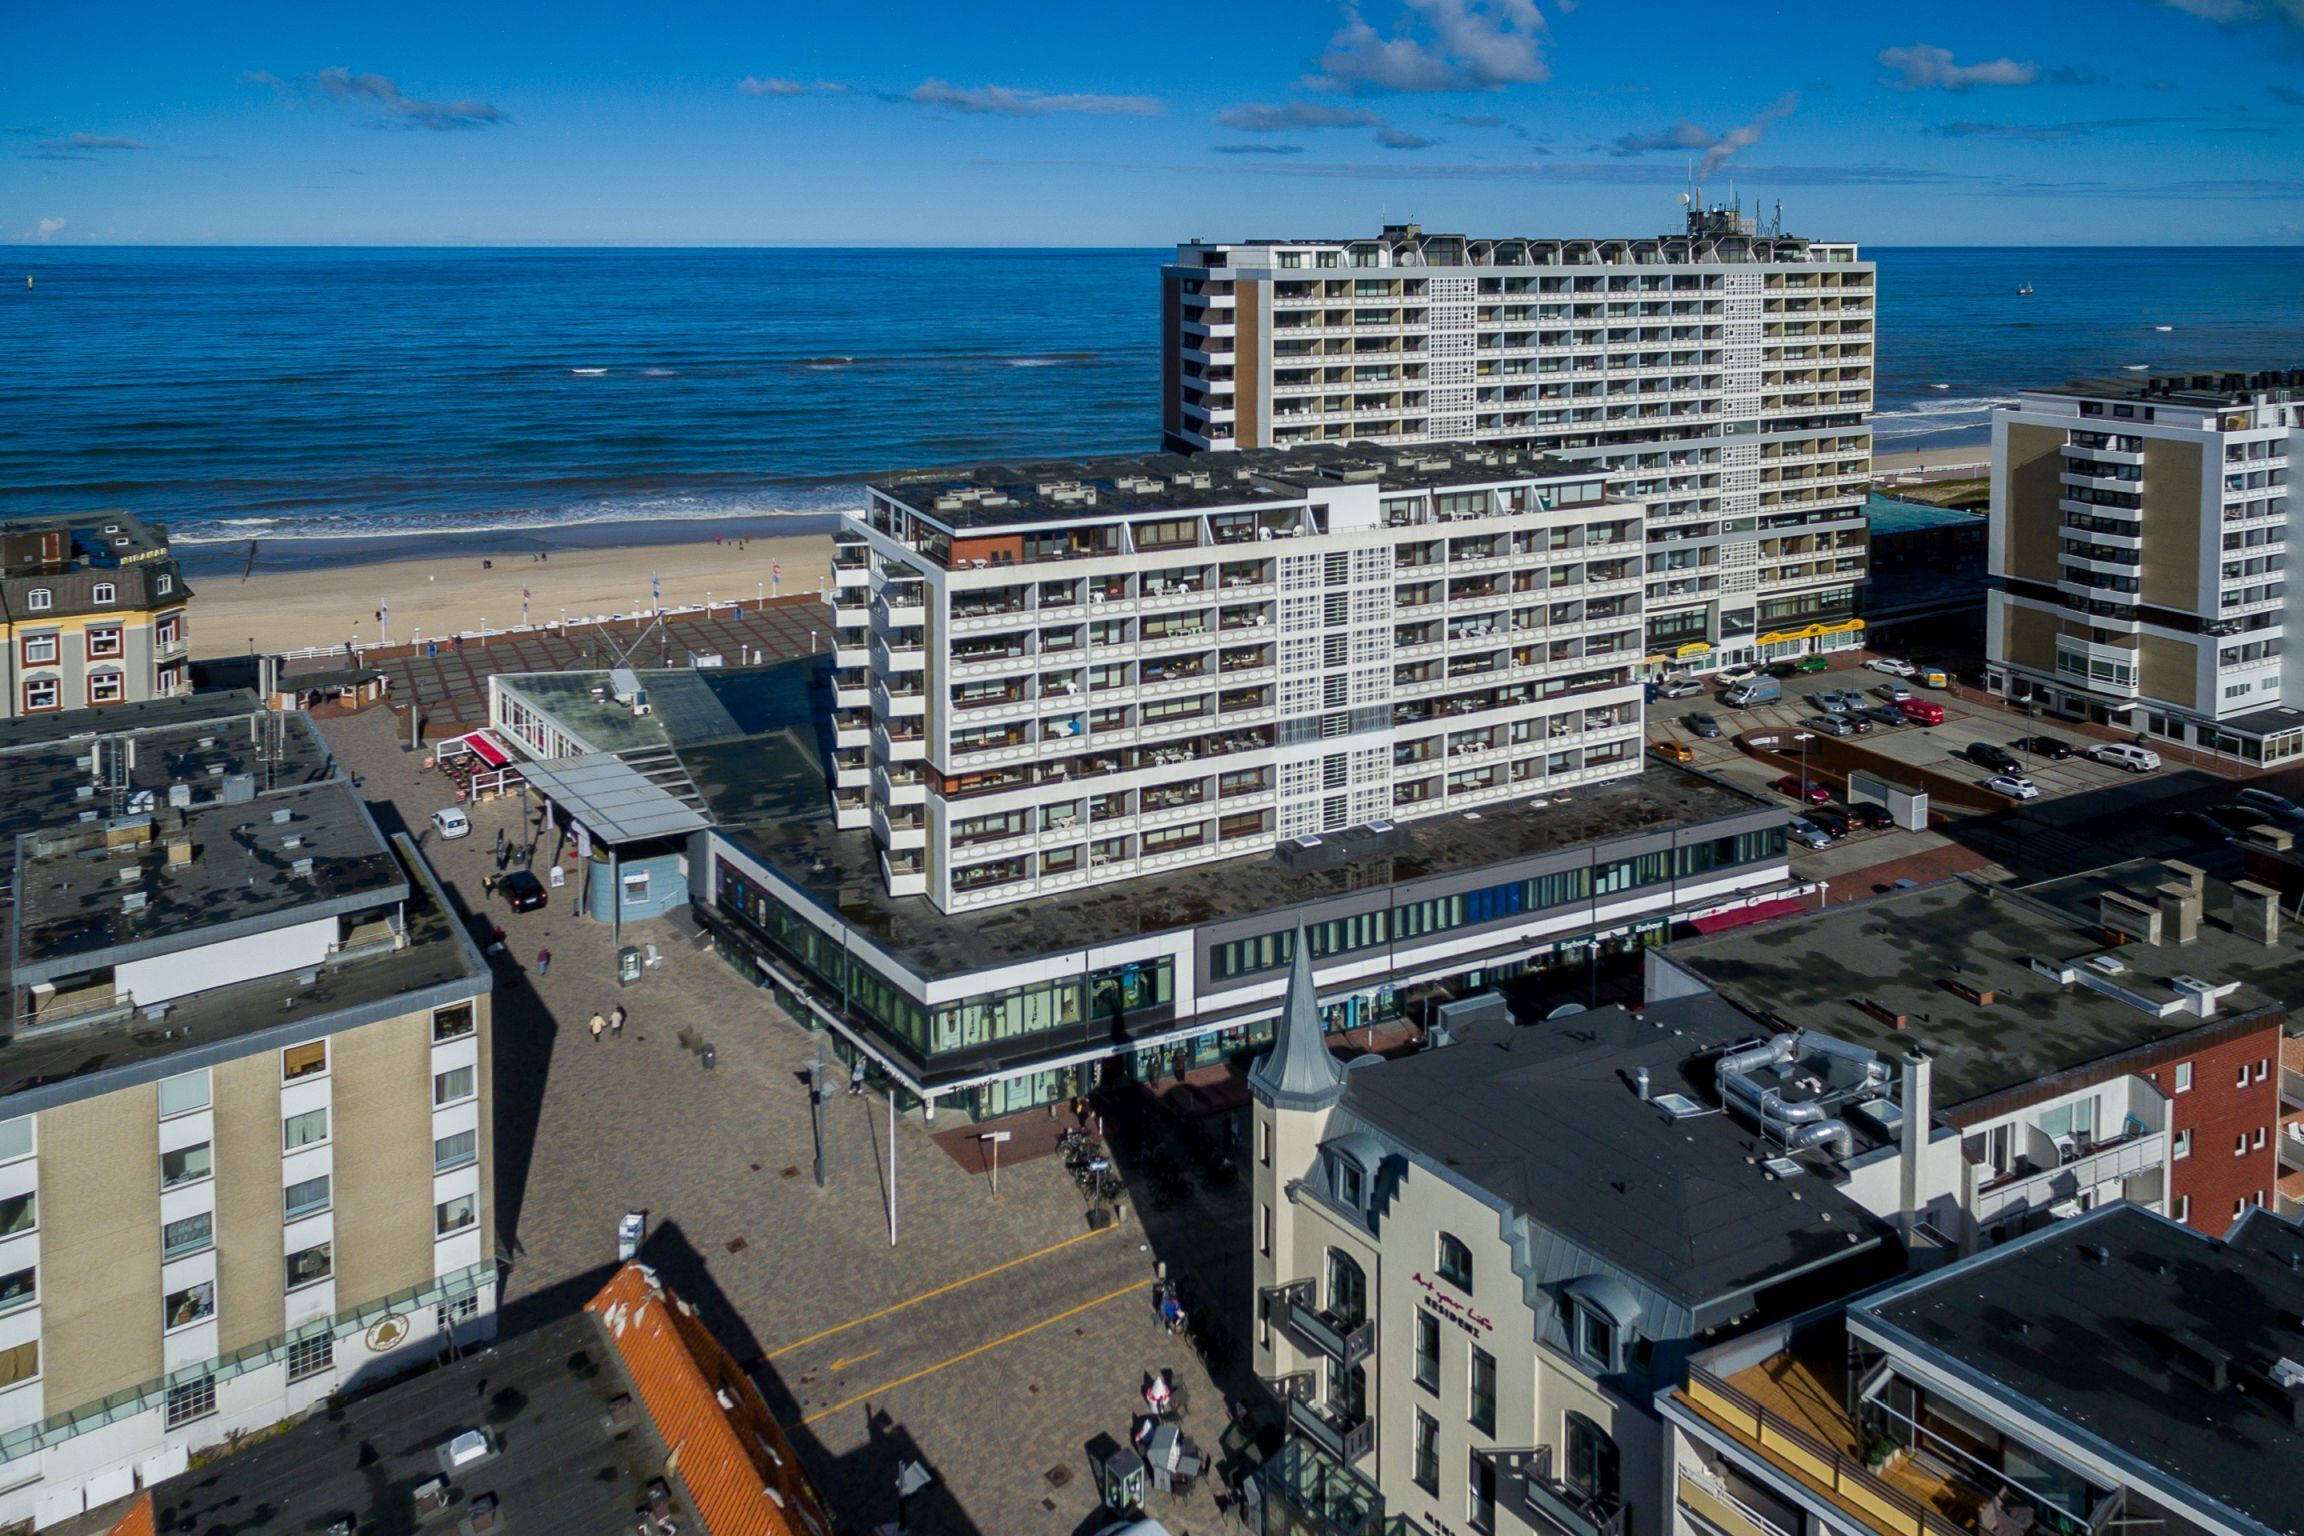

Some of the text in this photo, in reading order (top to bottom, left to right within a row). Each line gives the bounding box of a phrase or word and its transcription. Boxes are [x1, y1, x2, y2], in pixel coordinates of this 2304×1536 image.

[948, 1077, 1000, 1094] Tamaris
[1412, 1272, 1435, 1291] Art
[1424, 1295, 1480, 1339] RESIDENZ
